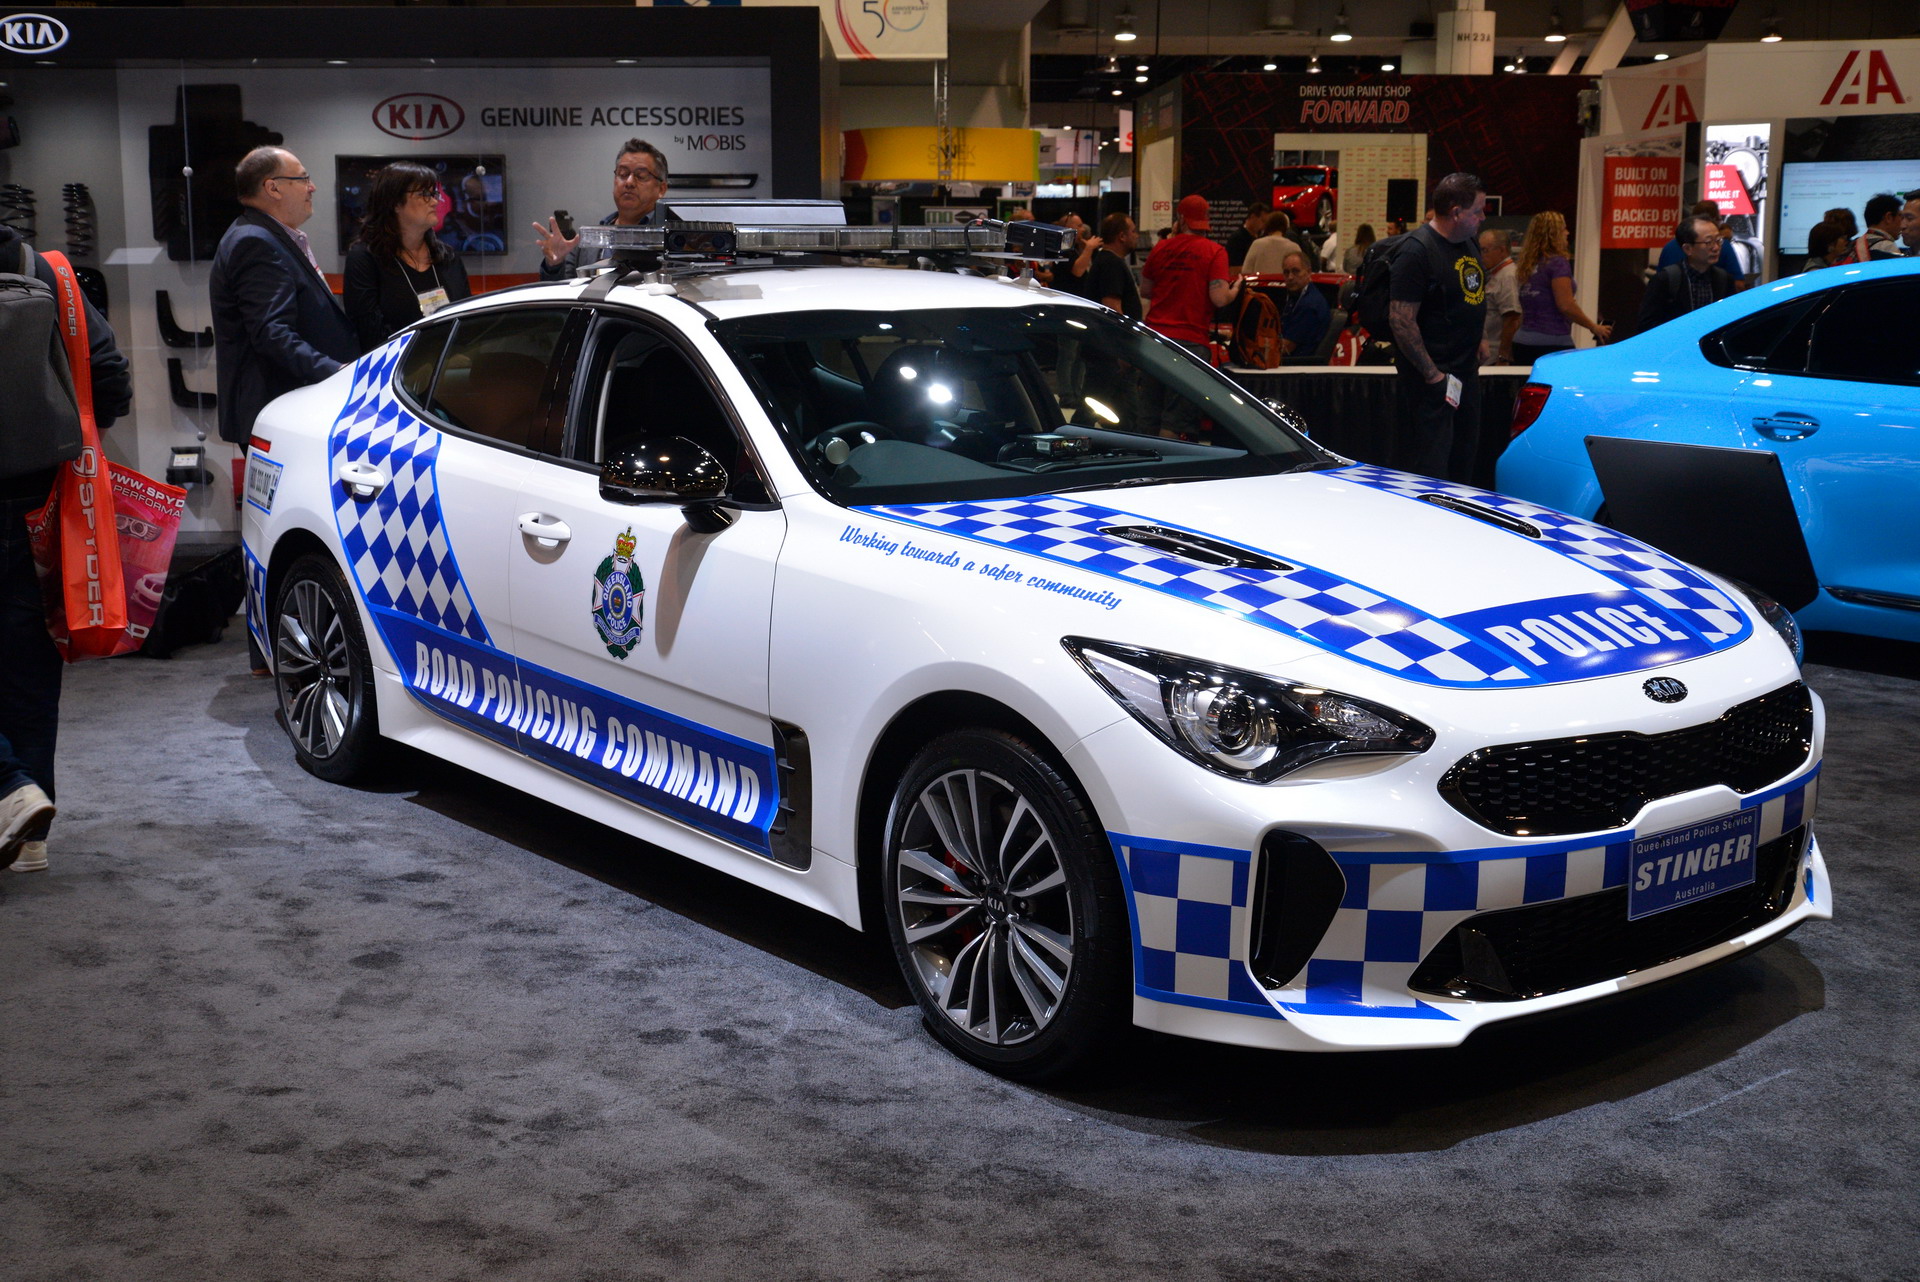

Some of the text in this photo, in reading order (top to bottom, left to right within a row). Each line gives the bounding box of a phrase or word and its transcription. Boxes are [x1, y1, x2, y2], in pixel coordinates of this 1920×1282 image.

[4, 22, 57, 44] KIA
[1300, 85, 1411, 97] DRIVE YOUR PAINT SHOP
[388, 104, 450, 129] KIA
[481, 106, 744, 127] GENUINE ACCESSORIES
[1300, 100, 1410, 124] FORWARD
[674, 134, 746, 150] by MOBIS
[1615, 167, 1668, 180] BUILT ON
[1709, 170, 1726, 179] BID.
[1708, 190, 1741, 199] MAKE IT
[1709, 180, 1726, 189] BUY.
[1613, 209, 1680, 222] BACKED BY
[63, 280, 77, 336] SPYDER
[113, 486, 184, 518] PERFORMA
[78, 482, 104, 626] SPYDER
[839, 524, 1123, 610] Working towards a safer community
[604, 573, 632, 608] QUEENSLAND
[607, 613, 627, 630] POLICE
[1484, 604, 1690, 666] POLICE
[1650, 678, 1685, 698] KIA
[413, 641, 760, 824] ROAD POLICING COMMAND
[1636, 814, 1752, 854] Queensland Police Service
[1635, 834, 1752, 892] STINGER
[1674, 882, 1716, 900] Australia
[988, 896, 1005, 912] KIA
